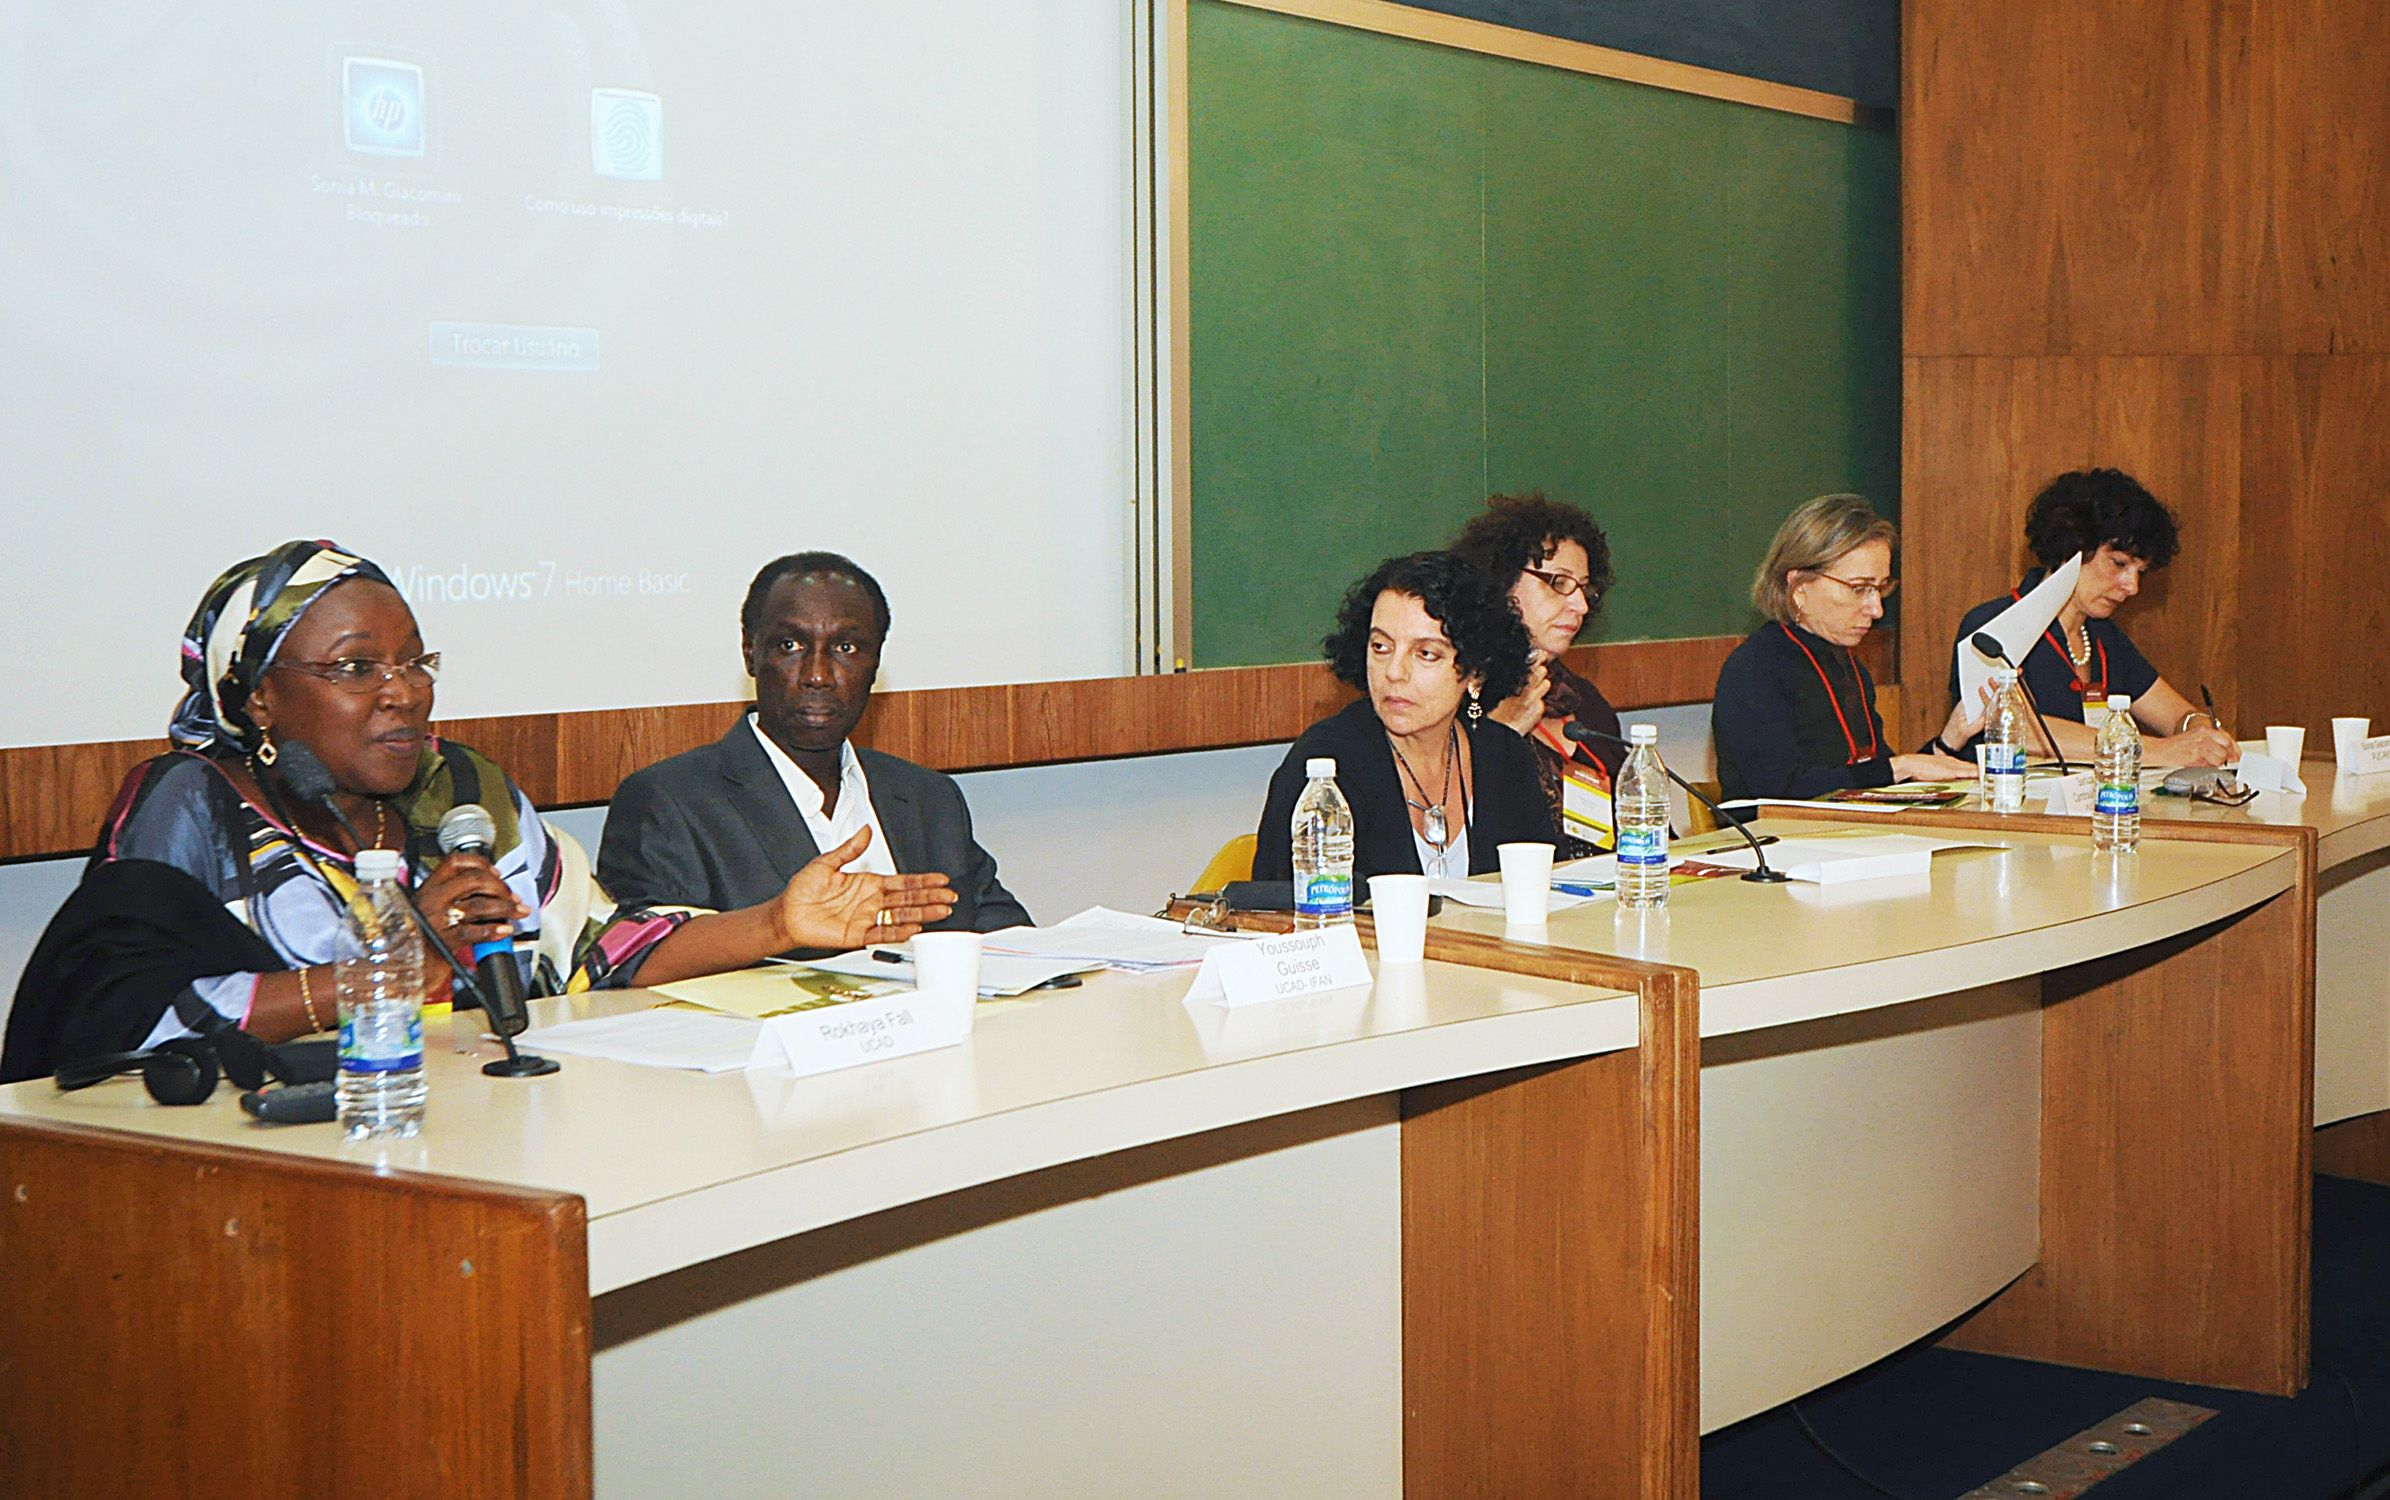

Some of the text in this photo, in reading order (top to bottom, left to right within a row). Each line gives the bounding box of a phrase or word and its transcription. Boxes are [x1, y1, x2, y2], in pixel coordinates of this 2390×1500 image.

[371, 90, 404, 133] hp
[311, 176, 354, 196] Sonia
[524, 195, 569, 215] Como
[600, 203, 674, 225] impressões
[676, 207, 730, 229] digitais?
[452, 333, 508, 357] Trocar
[390, 561, 690, 602] Windows 7 Home Basic
[1256, 934, 1326, 956] Youssouph
[1277, 959, 1320, 976] Guisse
[1275, 974, 1333, 995] UCAD- IFAN
[820, 1008, 915, 1041] Rokhaya Fall
